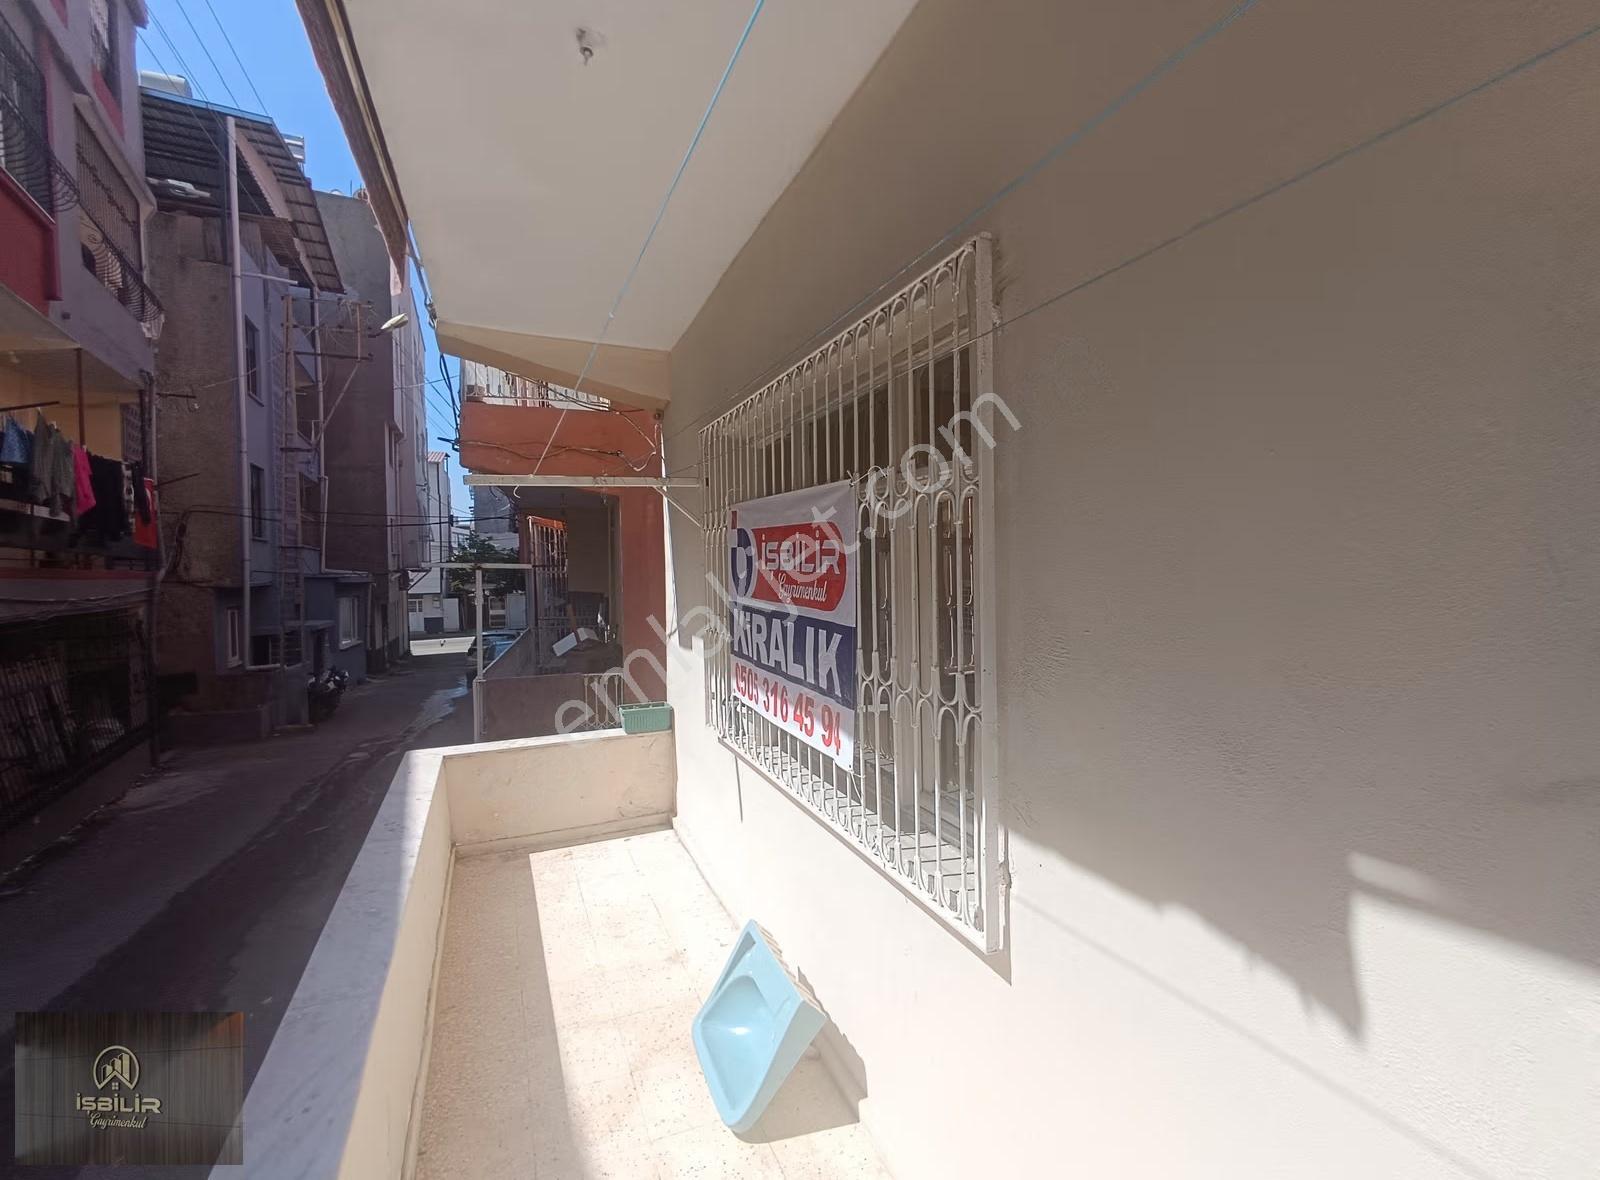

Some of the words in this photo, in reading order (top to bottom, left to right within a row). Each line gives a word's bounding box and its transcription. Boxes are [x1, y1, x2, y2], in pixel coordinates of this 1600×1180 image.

[735, 662, 759, 705] 0505
[763, 676, 789, 723] 316
[793, 692, 815, 738] 45
[821, 704, 842, 756] 94
